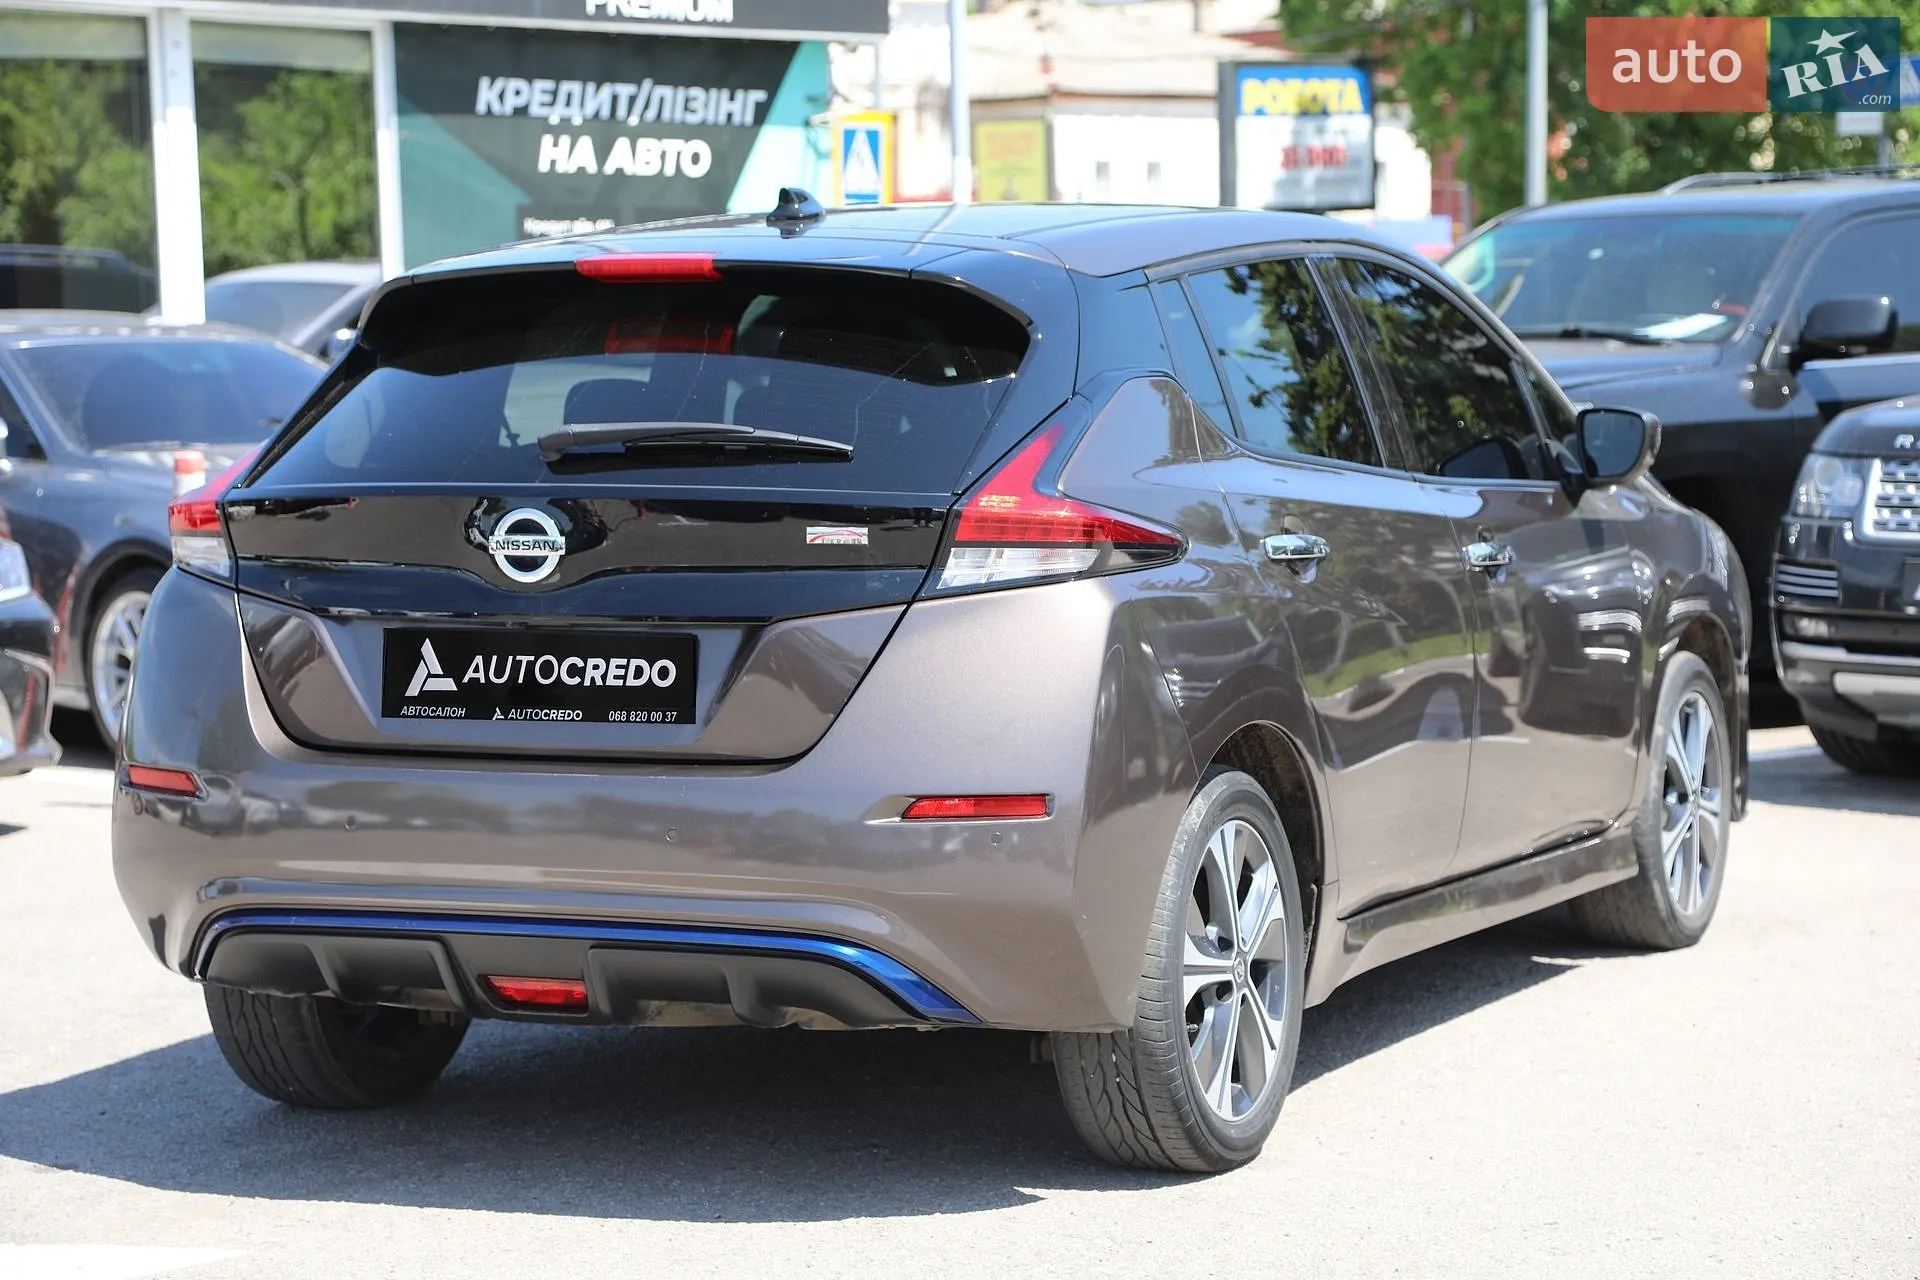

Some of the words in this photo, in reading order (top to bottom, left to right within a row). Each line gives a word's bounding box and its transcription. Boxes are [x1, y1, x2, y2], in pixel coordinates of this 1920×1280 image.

[585, 0, 734, 23] PREMIUM
[475, 76, 768, 126] КРЕДИТ/ЛІЗІНГ
[537, 133, 598, 175] НА
[603, 136, 712, 178] АВТО
[495, 540, 555, 551] NISSAN
[462, 654, 677, 688] AUTOCREDO
[400, 705, 466, 717] АВТОСАЛОН
[507, 708, 583, 721] AUTOCREDO
[608, 710, 626, 722] 068
[629, 710, 648, 722] 820
[650, 711, 662, 723] 00
[665, 711, 677, 722] 37
